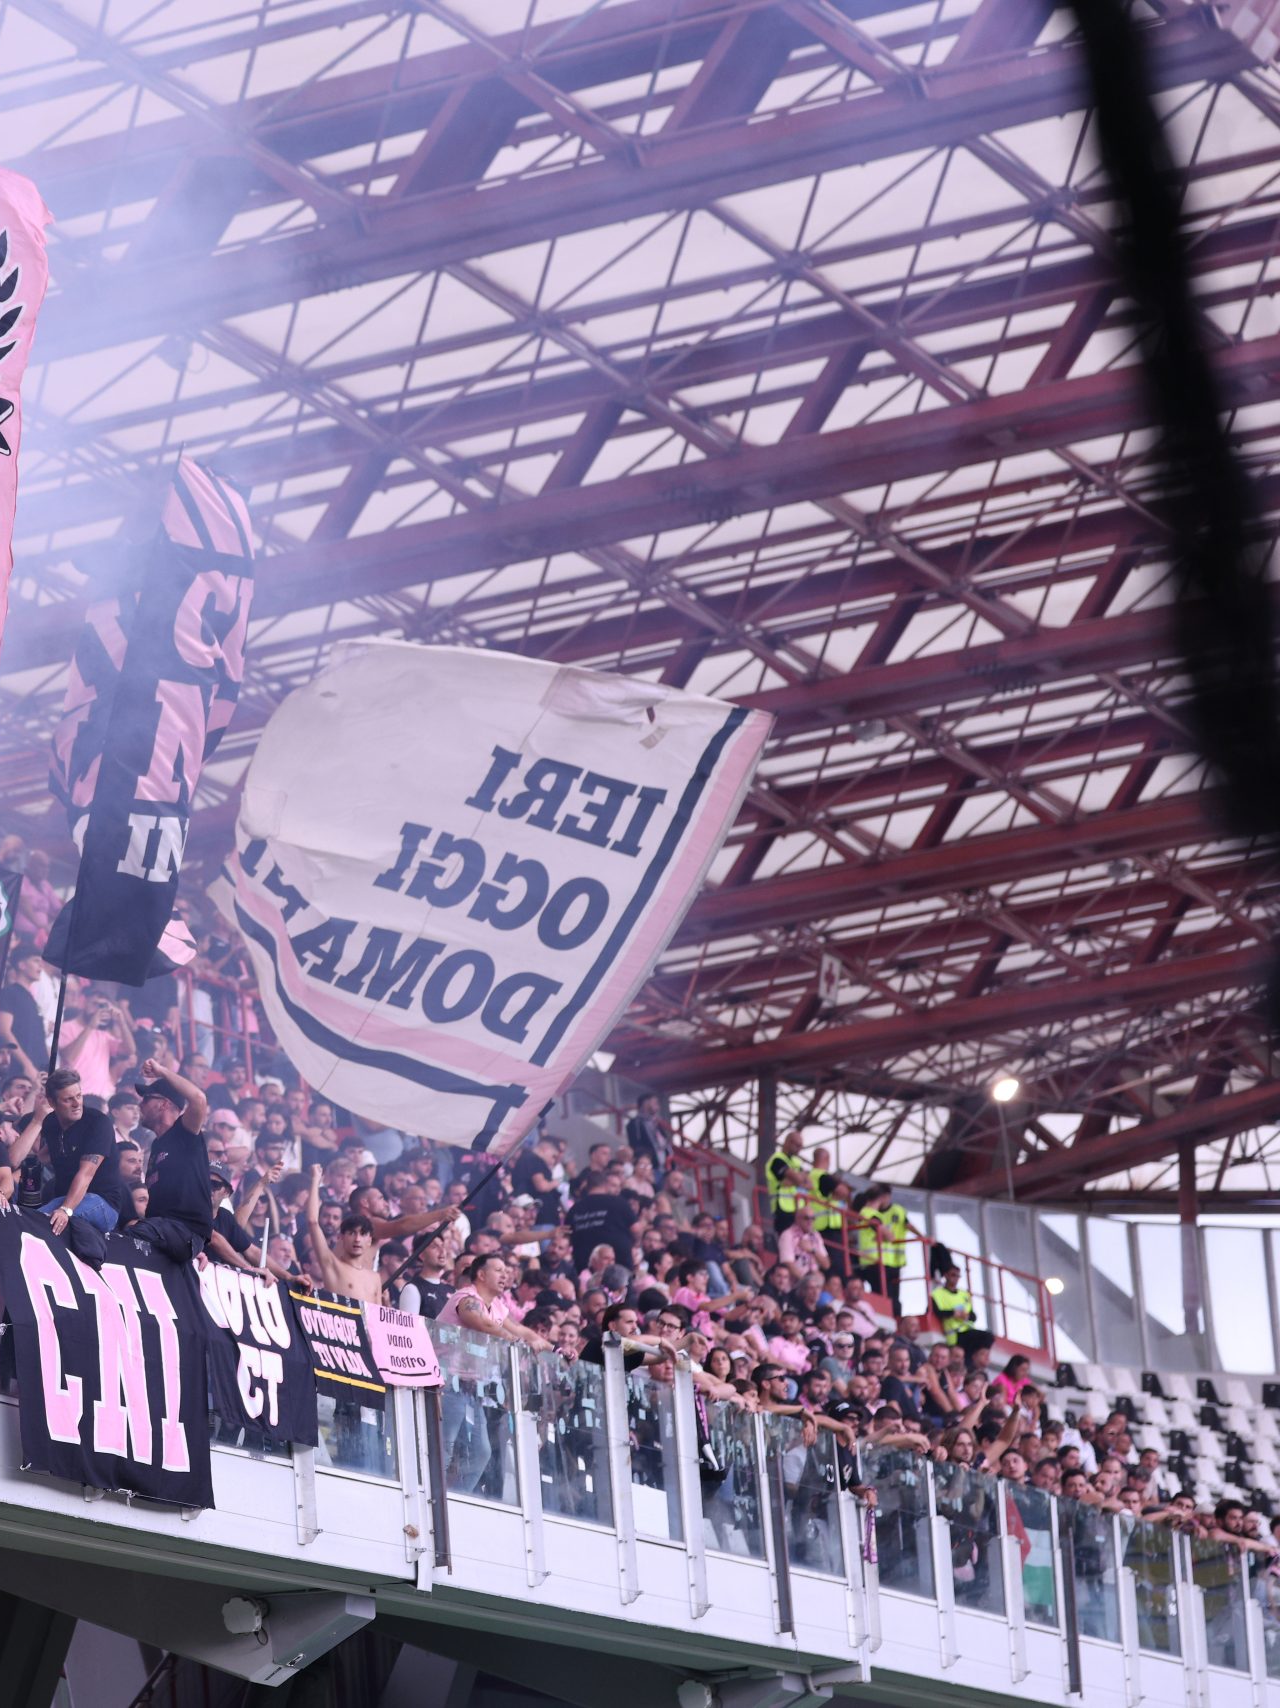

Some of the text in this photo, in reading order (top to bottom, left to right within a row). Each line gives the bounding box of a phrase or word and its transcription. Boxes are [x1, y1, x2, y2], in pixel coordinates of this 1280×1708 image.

[386, 1333, 413, 1349] vanto
[390, 1355, 426, 1369] nostro
[236, 1342, 284, 1427] CT
